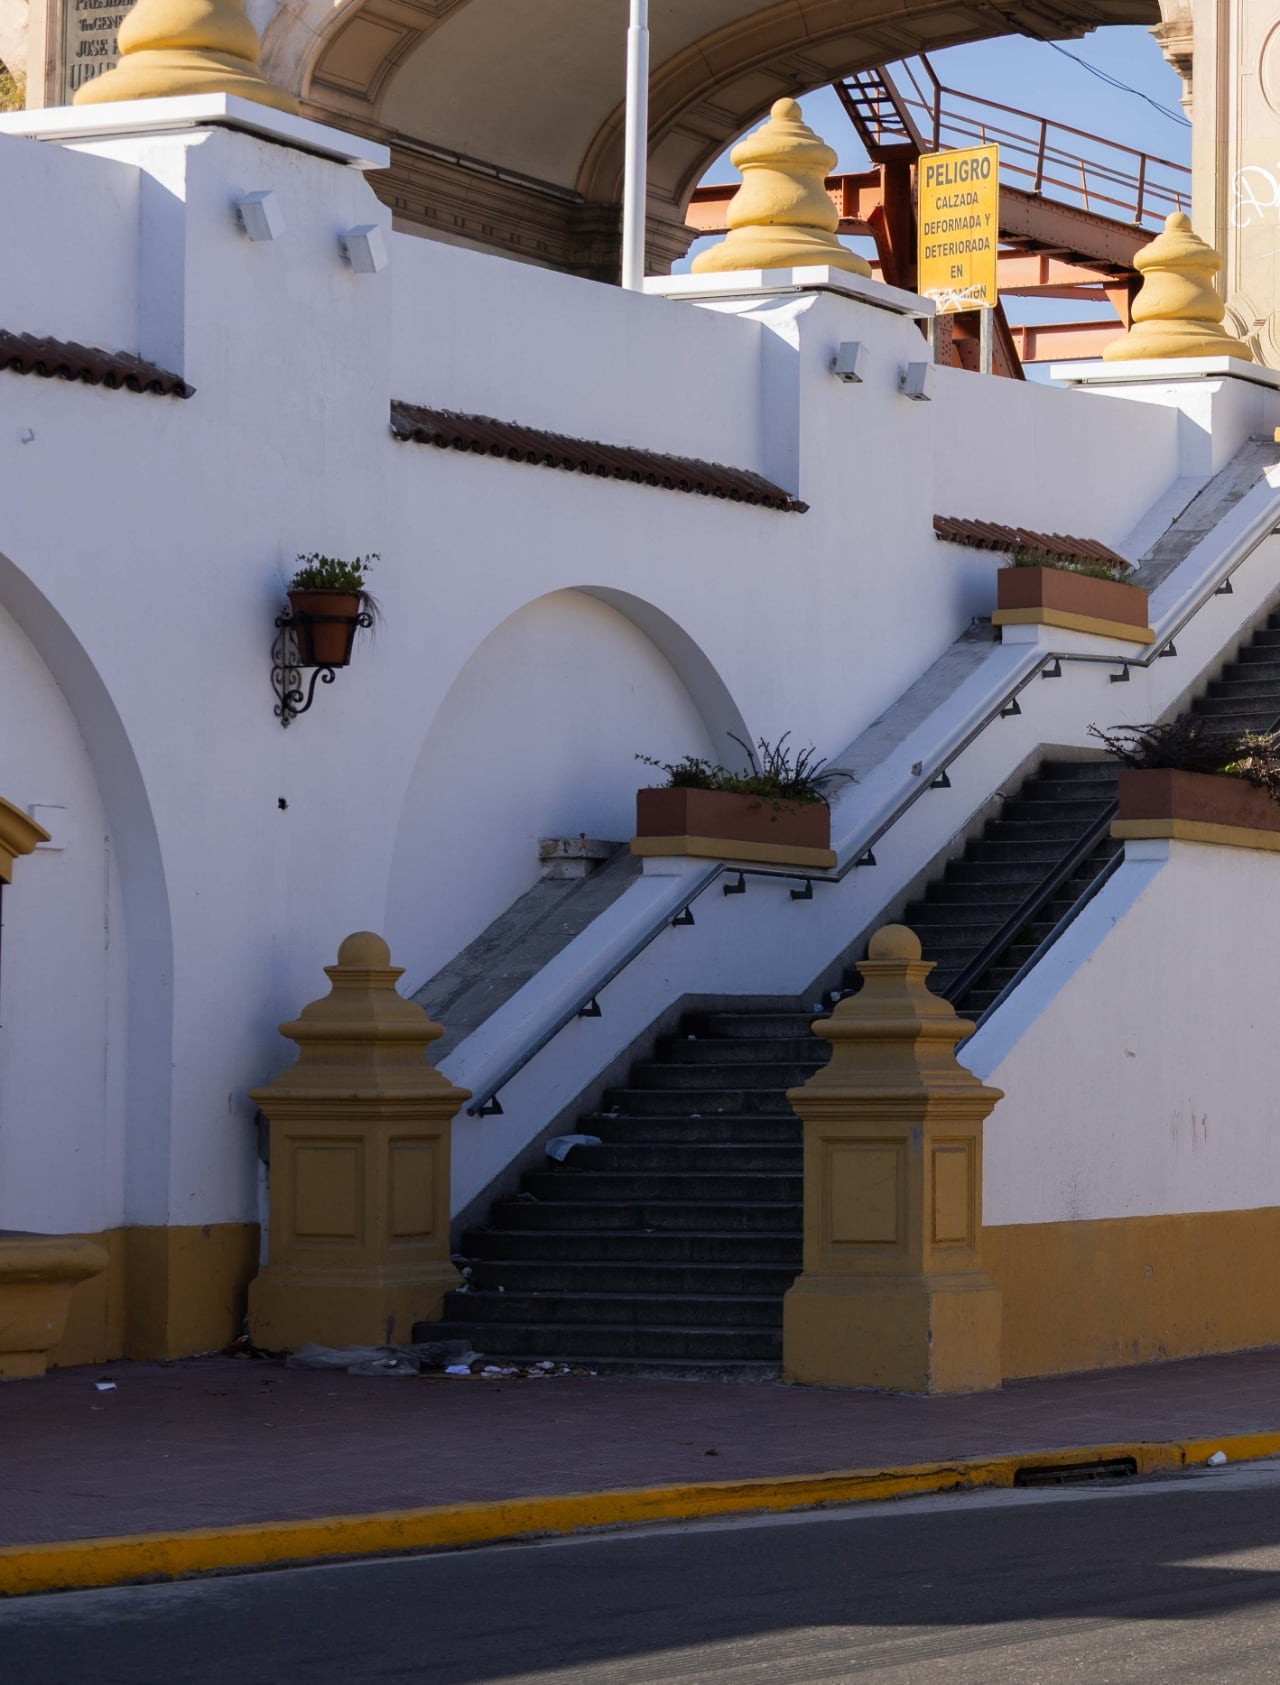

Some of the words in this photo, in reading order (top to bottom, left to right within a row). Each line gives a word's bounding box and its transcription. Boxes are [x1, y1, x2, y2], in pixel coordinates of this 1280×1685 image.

[76, 39, 108, 58] JOSE
[926, 157, 991, 187] PELIGRO
[936, 192, 978, 210] CALZADA
[924, 217, 981, 236] DEFORMADA
[985, 213, 991, 227] Y
[925, 237, 991, 259] DETERIORADA
[951, 264, 963, 280] EN
